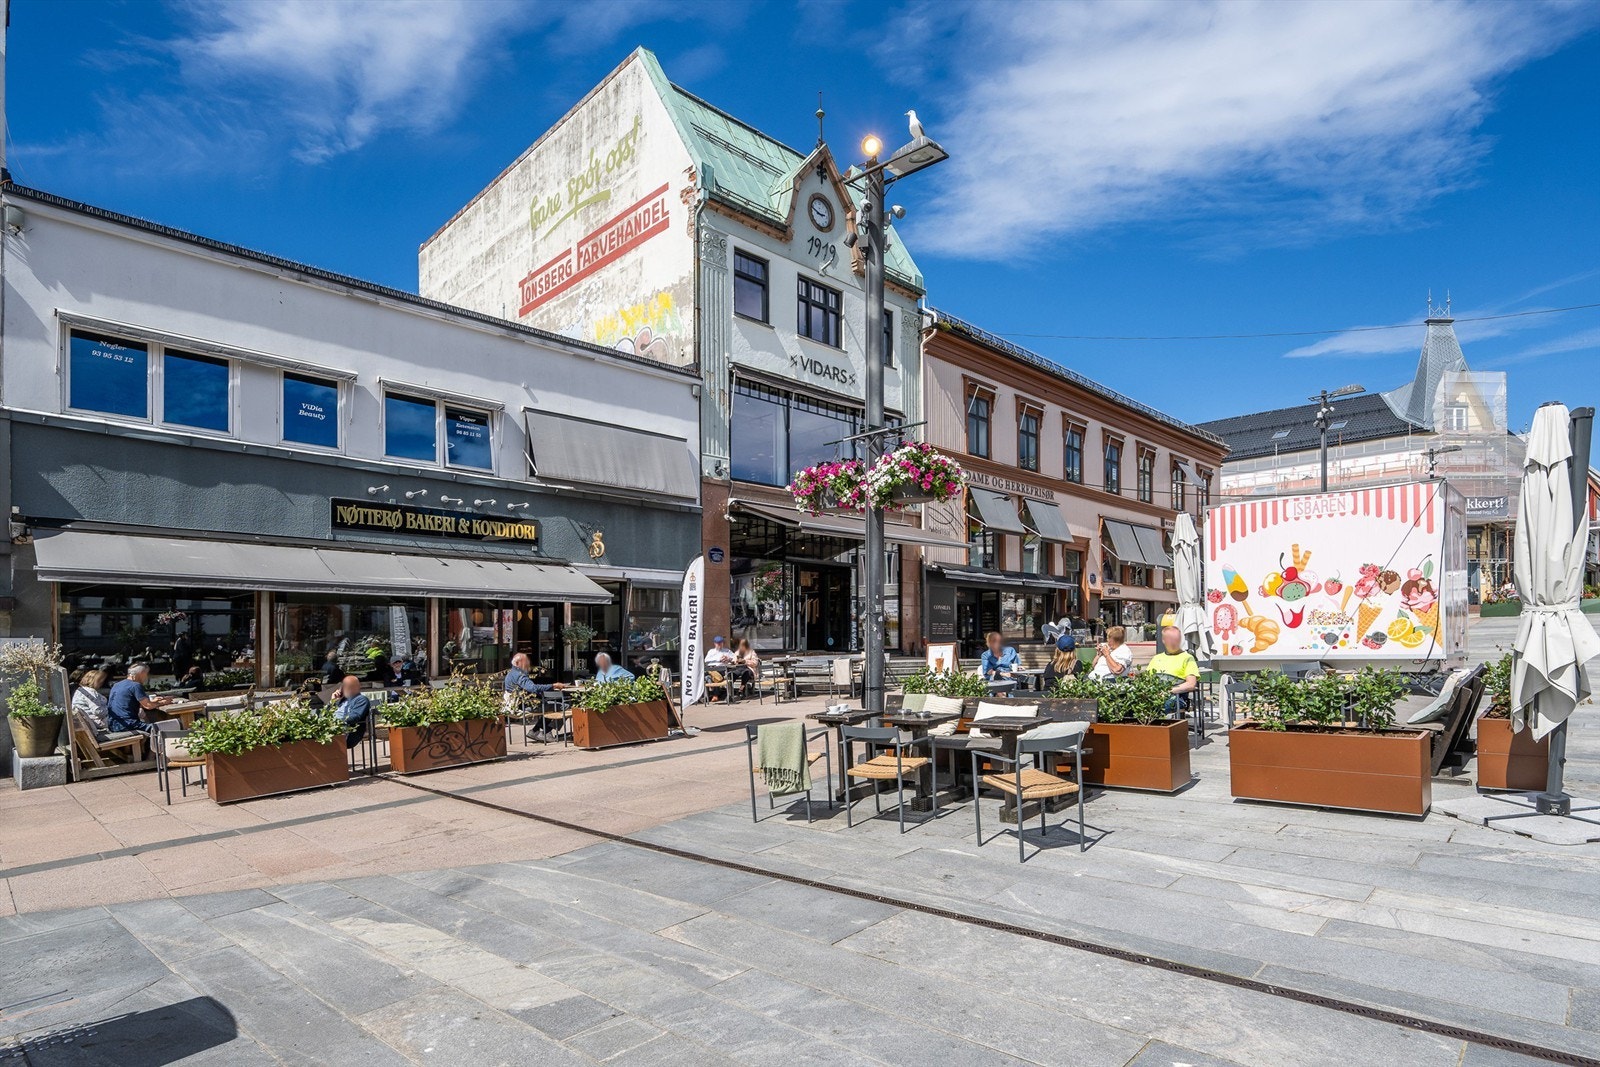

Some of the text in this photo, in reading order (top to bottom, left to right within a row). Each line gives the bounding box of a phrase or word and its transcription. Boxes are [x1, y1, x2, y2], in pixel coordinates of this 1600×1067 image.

[576, 197, 670, 272] FARVEHANDEL
[807, 235, 837, 262] 1919
[99, 340, 127, 351] Negler
[799, 355, 848, 385] VIDARS
[298, 409, 326, 420] Beauty
[301, 402, 324, 412] ViDia
[965, 470, 1055, 501] DAME OG HERREFRISØR
[1293, 497, 1346, 516] ISBAREN
[336, 504, 536, 540] NØTTERØ BAKERI & KONDITORI
[688, 595, 698, 640] BAKERI
